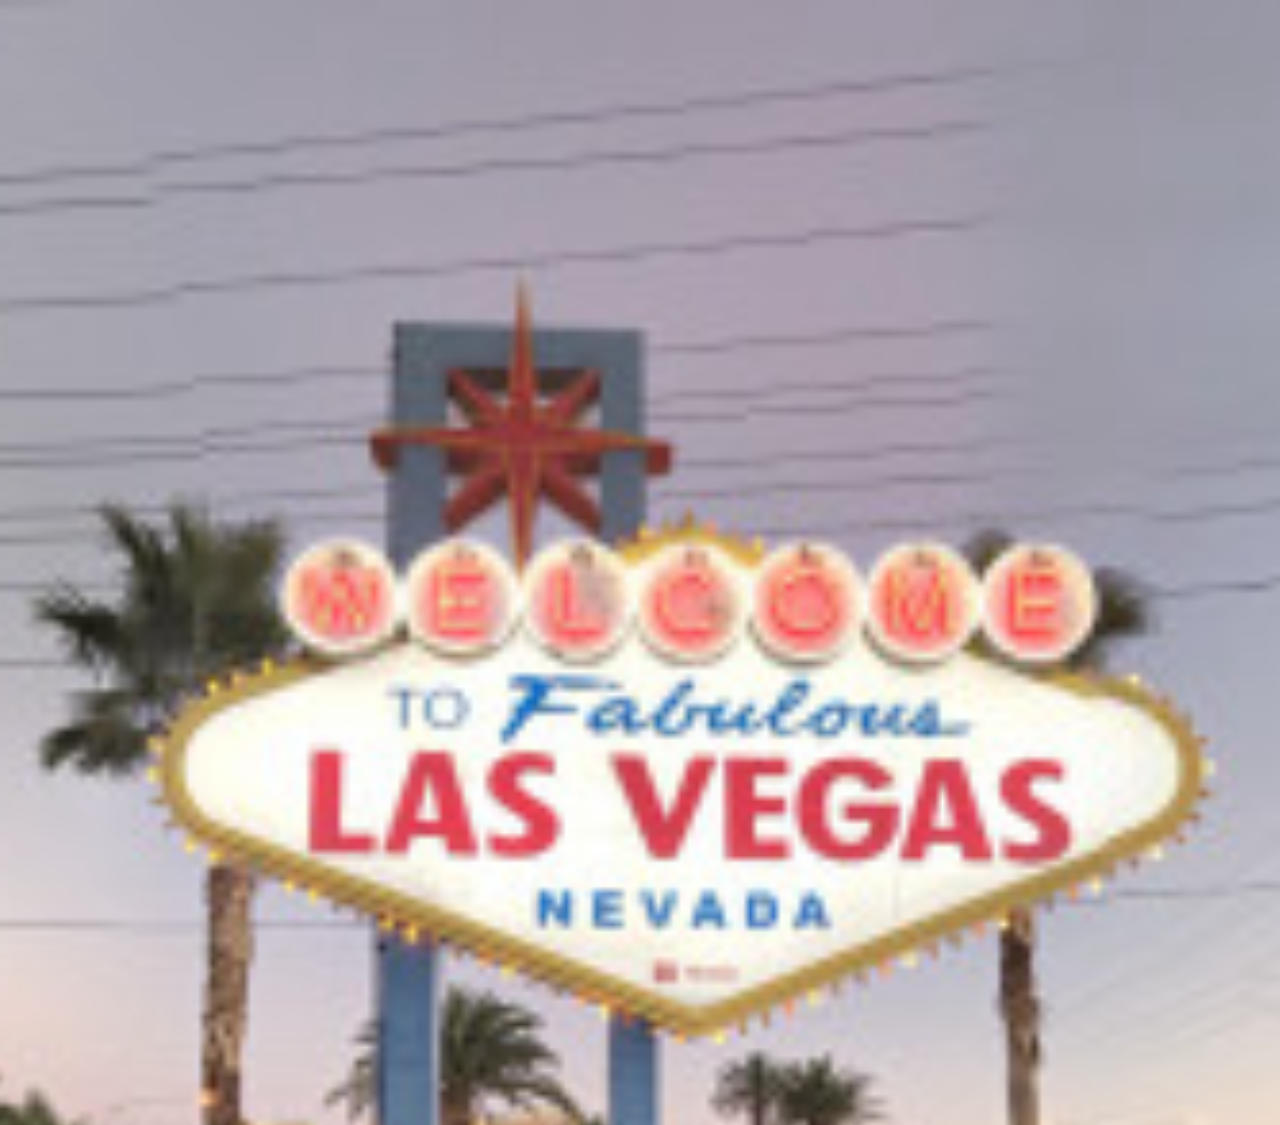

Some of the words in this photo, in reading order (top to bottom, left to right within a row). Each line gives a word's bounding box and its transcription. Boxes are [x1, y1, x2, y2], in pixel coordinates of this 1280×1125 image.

[298, 562, 1065, 642] WELCOME
[386, 684, 471, 731] TO
[499, 673, 971, 744] Fabulous
[308, 749, 563, 857] LAS
[609, 752, 1073, 861] VEGAS
[536, 888, 832, 929] NEVADA
